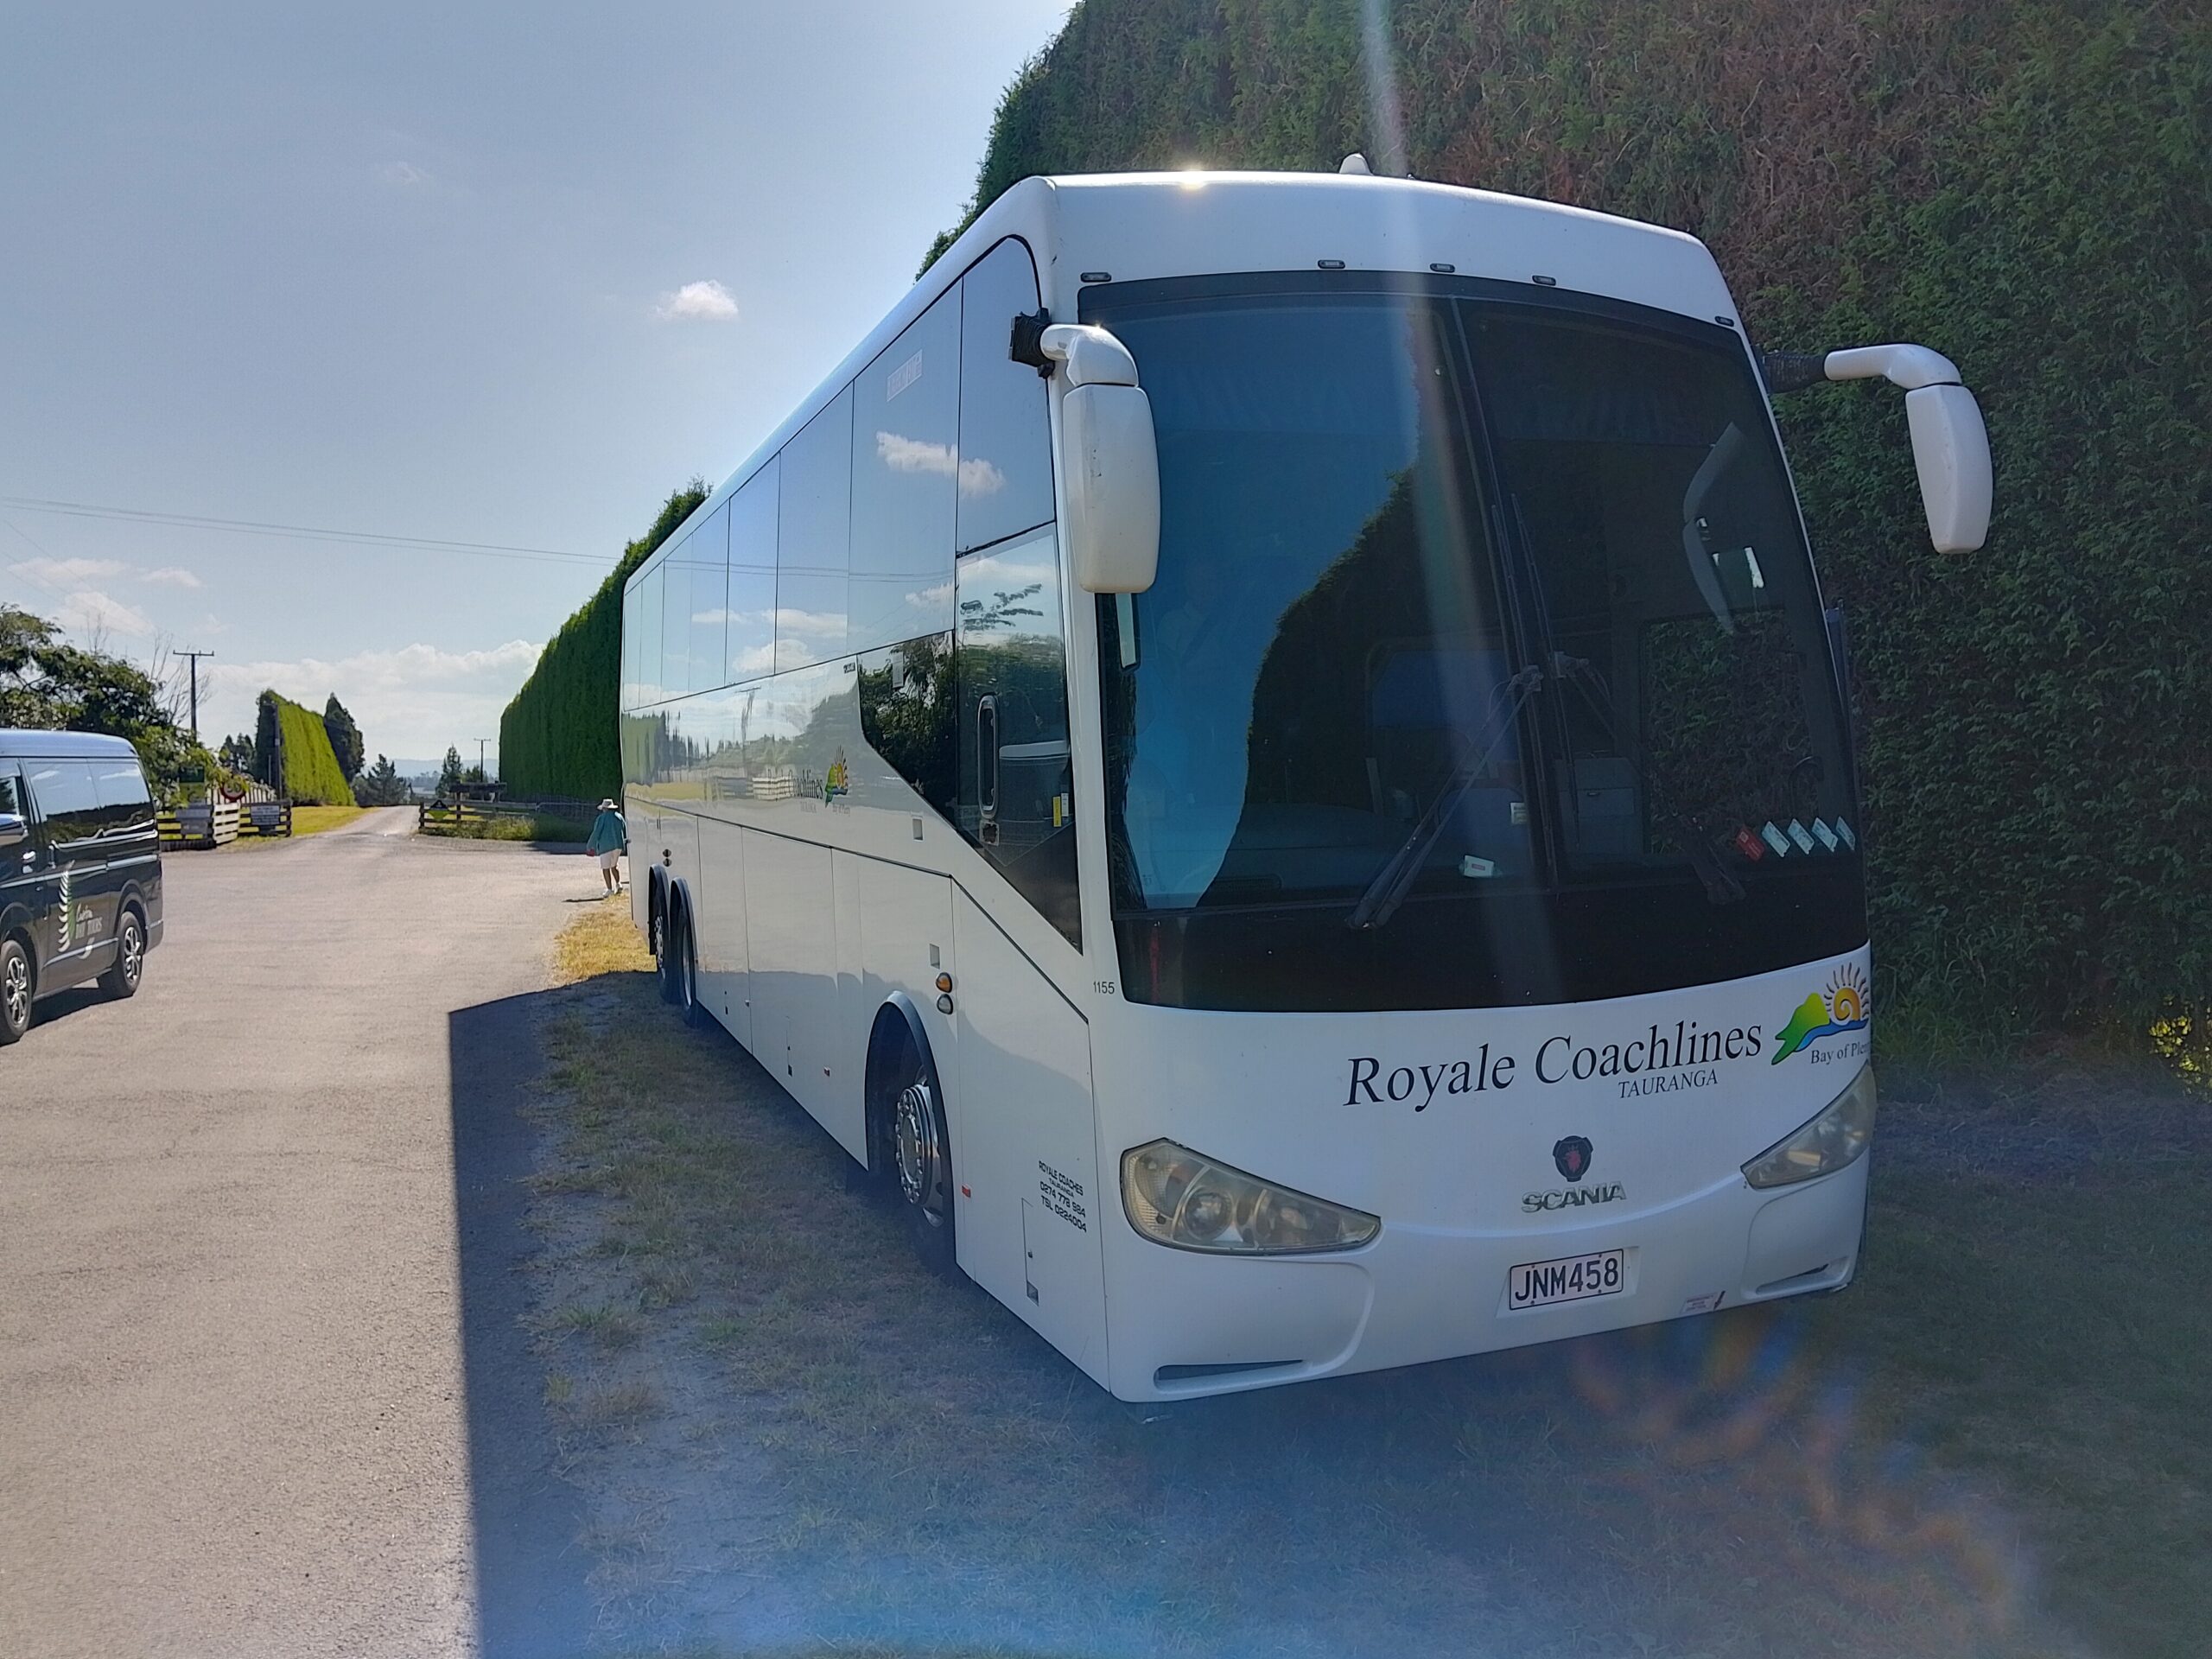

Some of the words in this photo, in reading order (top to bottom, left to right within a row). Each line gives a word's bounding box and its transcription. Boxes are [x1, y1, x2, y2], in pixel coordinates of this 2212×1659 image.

[1093, 981, 1116, 995] 1155
[1343, 1043, 1516, 1113] Royale
[1535, 1020, 1763, 1084] Coachlines
[1811, 1049, 1834, 1065] Bay
[1836, 1043, 1850, 1059] of
[1618, 1069, 1719, 1099] TAURANGA
[1039, 1160, 1058, 1180] ROYALE
[1058, 1172, 1084, 1197] COACHES
[1039, 1180, 1057, 1199] 0274
[1521, 1181, 1627, 1213] SCANIA
[1054, 1204, 1087, 1233] 0224004
[1515, 1257, 1618, 1301] JNM458
